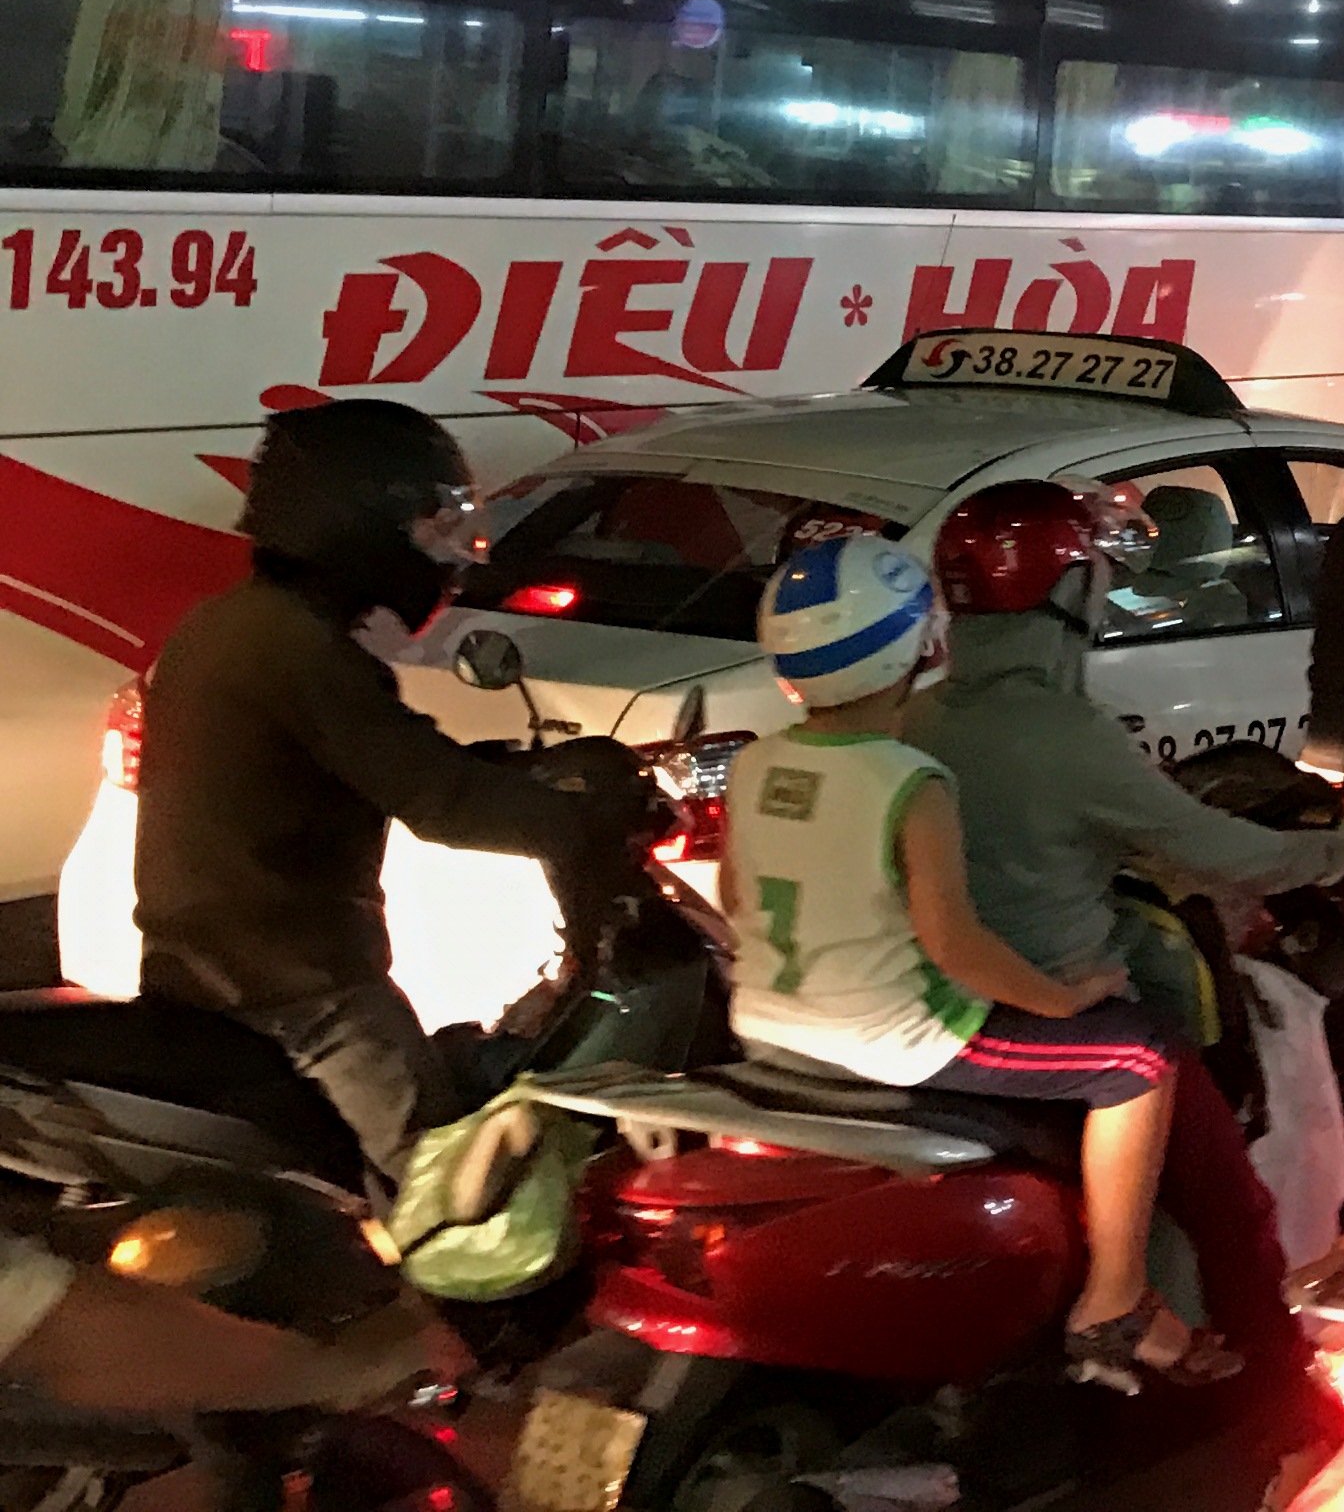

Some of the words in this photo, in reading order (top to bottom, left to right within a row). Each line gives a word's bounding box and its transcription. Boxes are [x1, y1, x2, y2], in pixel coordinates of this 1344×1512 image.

[1, 228, 258, 310] 143.94
[318, 226, 816, 396] ĐIỀU
[901, 237, 1197, 346] HÒA
[972, 345, 1074, 381] 38.27
[1076, 354, 1126, 386] 27
[1125, 357, 1175, 390] 27
